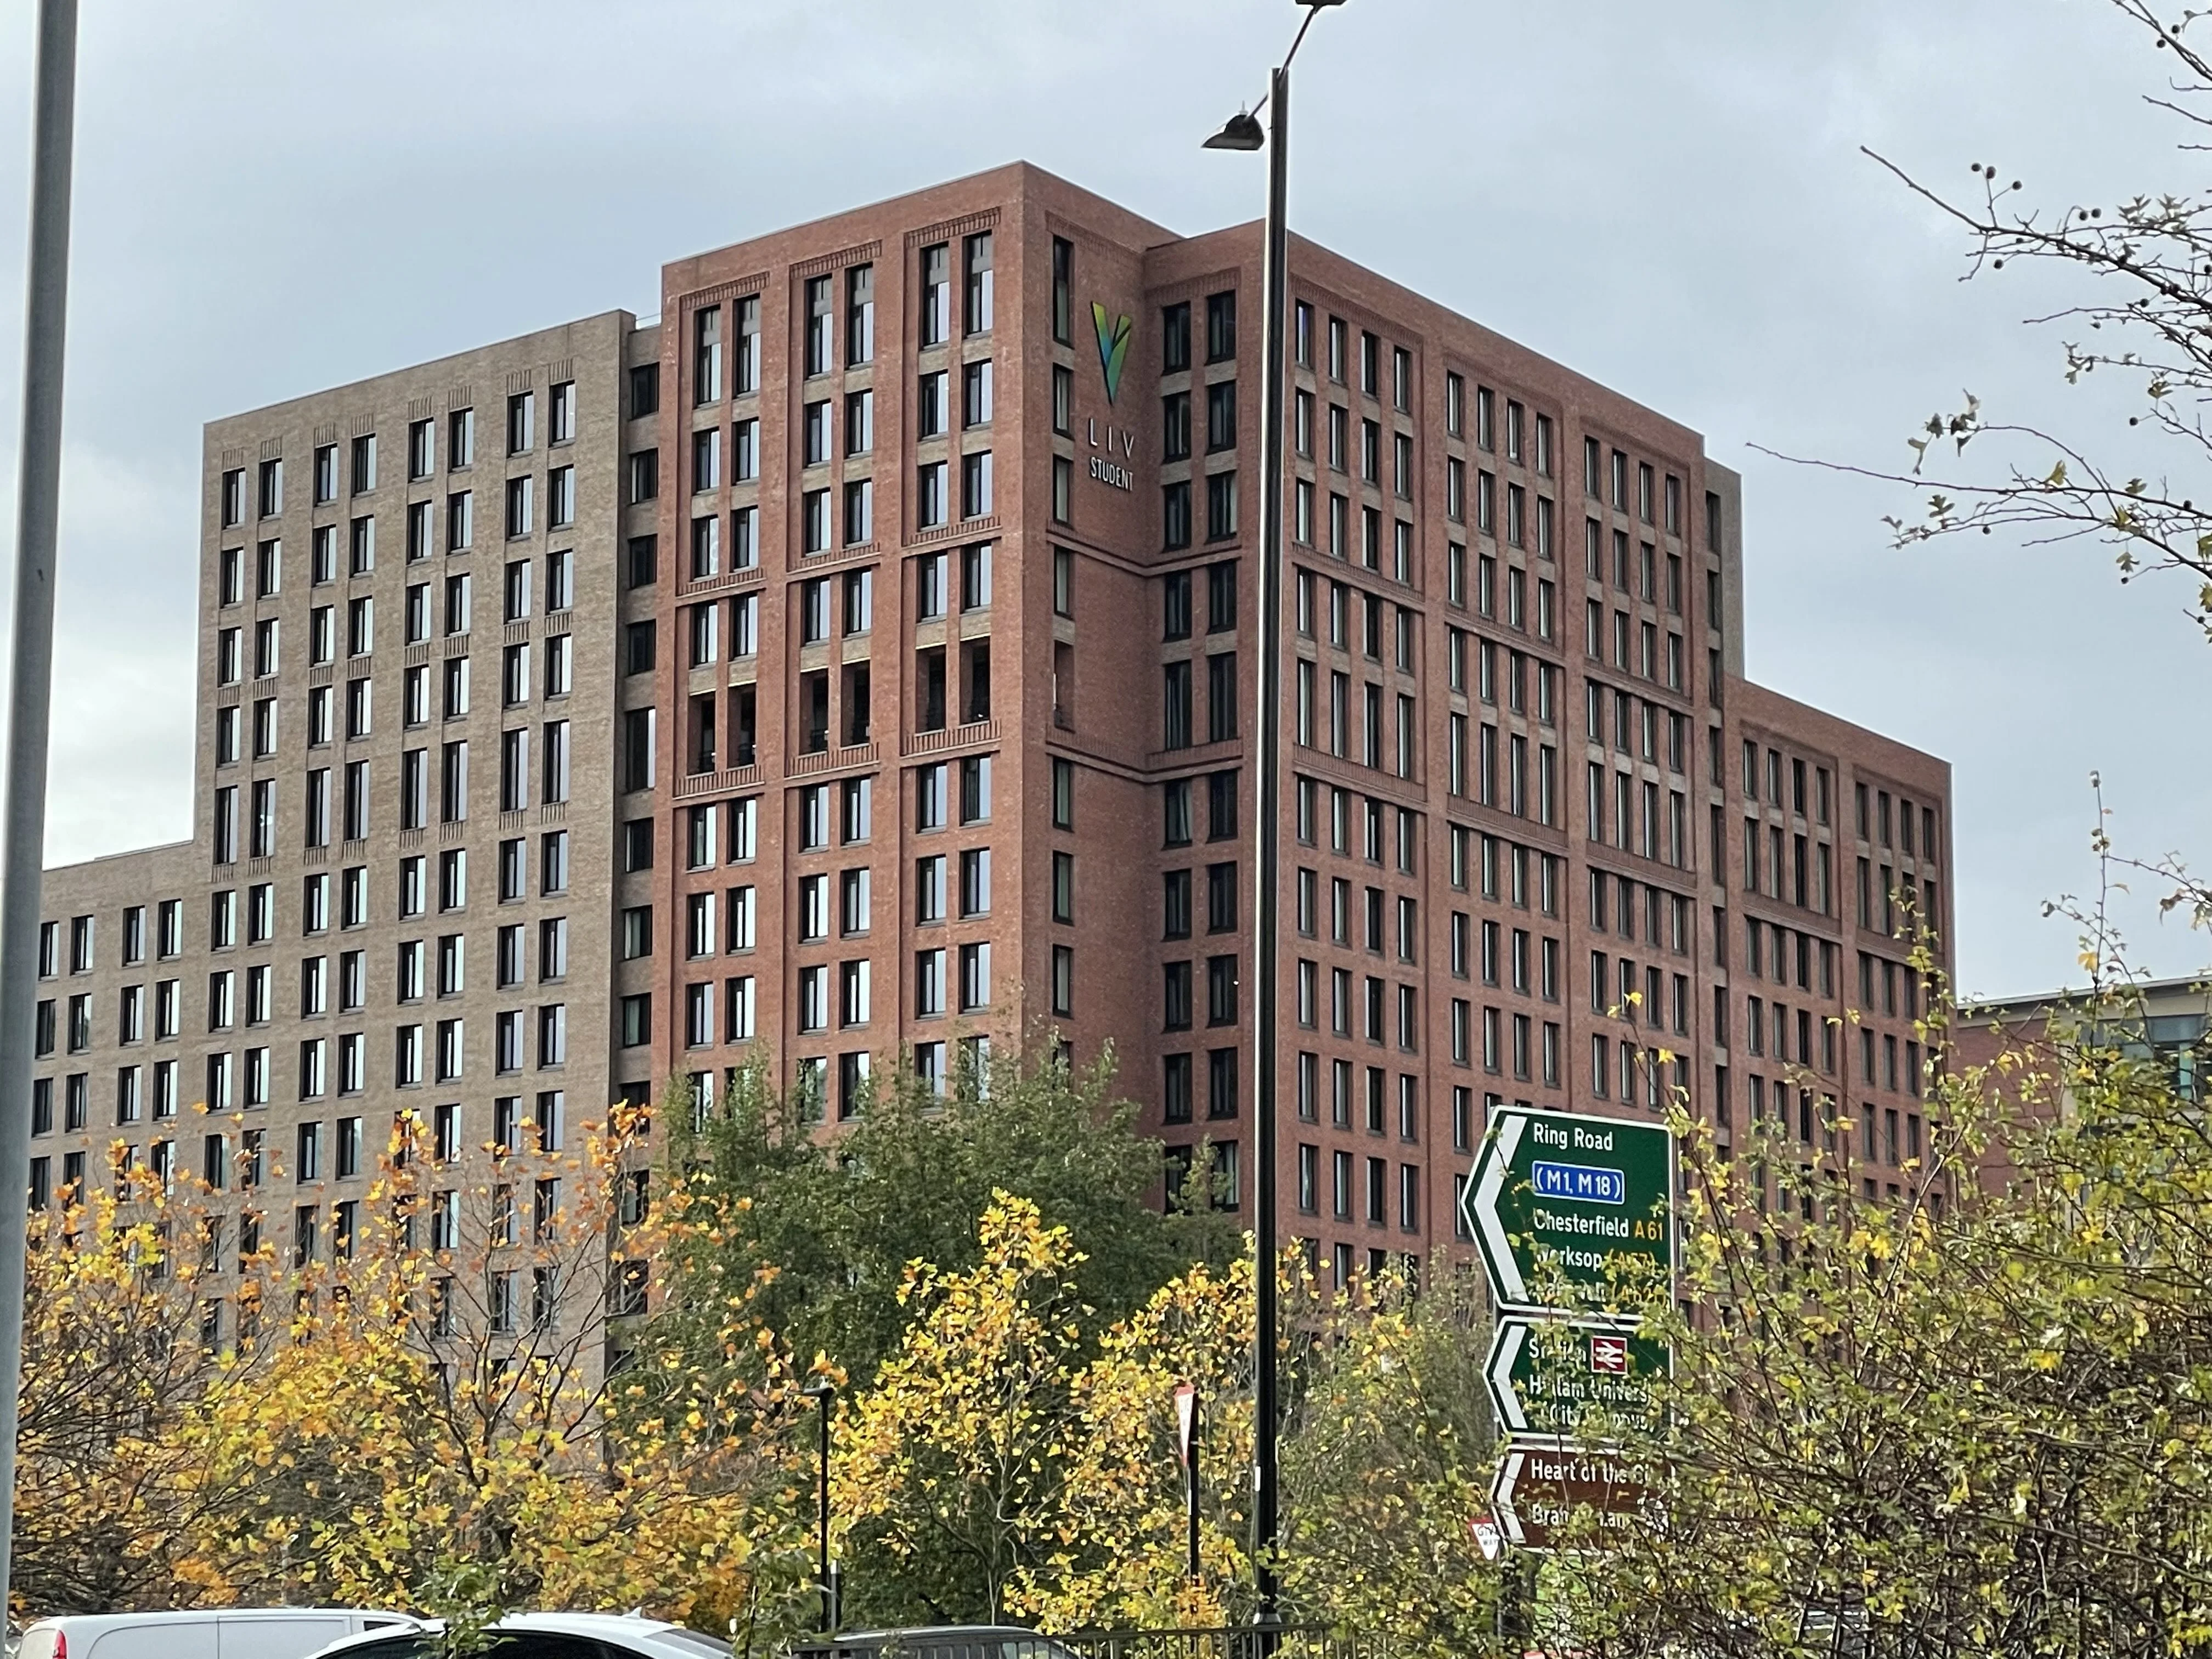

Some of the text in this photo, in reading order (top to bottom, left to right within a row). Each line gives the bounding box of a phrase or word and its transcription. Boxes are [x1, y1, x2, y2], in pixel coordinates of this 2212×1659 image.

[1089, 418, 1135, 458] LIV
[1090, 456, 1133, 491] STUDENT
[1533, 1122, 1613, 1151] Ring Road
[1534, 1209, 1663, 1241] Chesterfield A61
[1608, 1248, 1656, 1276] (A7)
[1528, 1336, 1587, 1362] Stin
[1530, 1374, 1654, 1403] Hlam Univers
[1531, 1458, 1576, 1481] Heart
[1602, 1462, 1627, 1483] the
[1633, 1463, 1654, 1485] Ci
[1478, 1525, 1495, 1536] GIV
[1599, 1508, 1629, 1528] Lan
